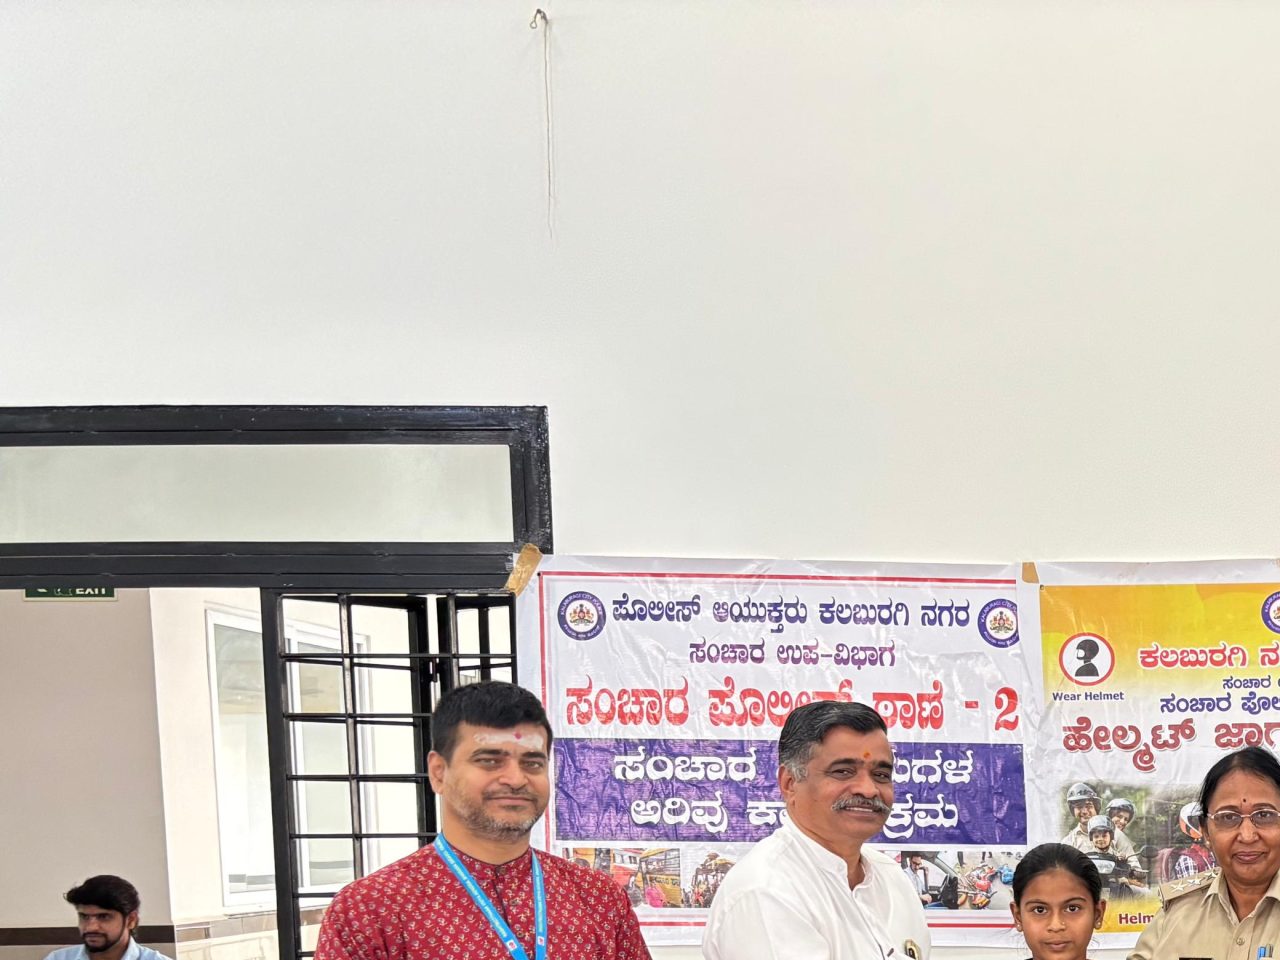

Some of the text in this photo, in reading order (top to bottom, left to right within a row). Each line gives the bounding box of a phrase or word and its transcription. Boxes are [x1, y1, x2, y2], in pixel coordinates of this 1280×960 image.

[612, 592, 970, 633] ಪೊಲೀಸ್ ಆಯುಕ್ತರು ಕಲಬುರಗಿ ನಗರ
[689, 636, 896, 670] ಸಂಚಾರ ಉಪ-ವಿಭಾಗ
[1140, 644, 1247, 668] ಕಲಬುರಗಿ
[1052, 691, 1124, 701] Wear Helmet
[1222, 675, 1271, 689] ಸಂಚಾರ
[566, 674, 689, 726] ಸಂಚಾರ
[995, 687, 1019, 731] 2
[1160, 692, 1231, 713] ಸಂಚಾರ
[613, 746, 757, 781] ಸಂಚಾರ
[631, 791, 728, 833] ಅರಿವು
[1118, 912, 1154, 925] Helm
